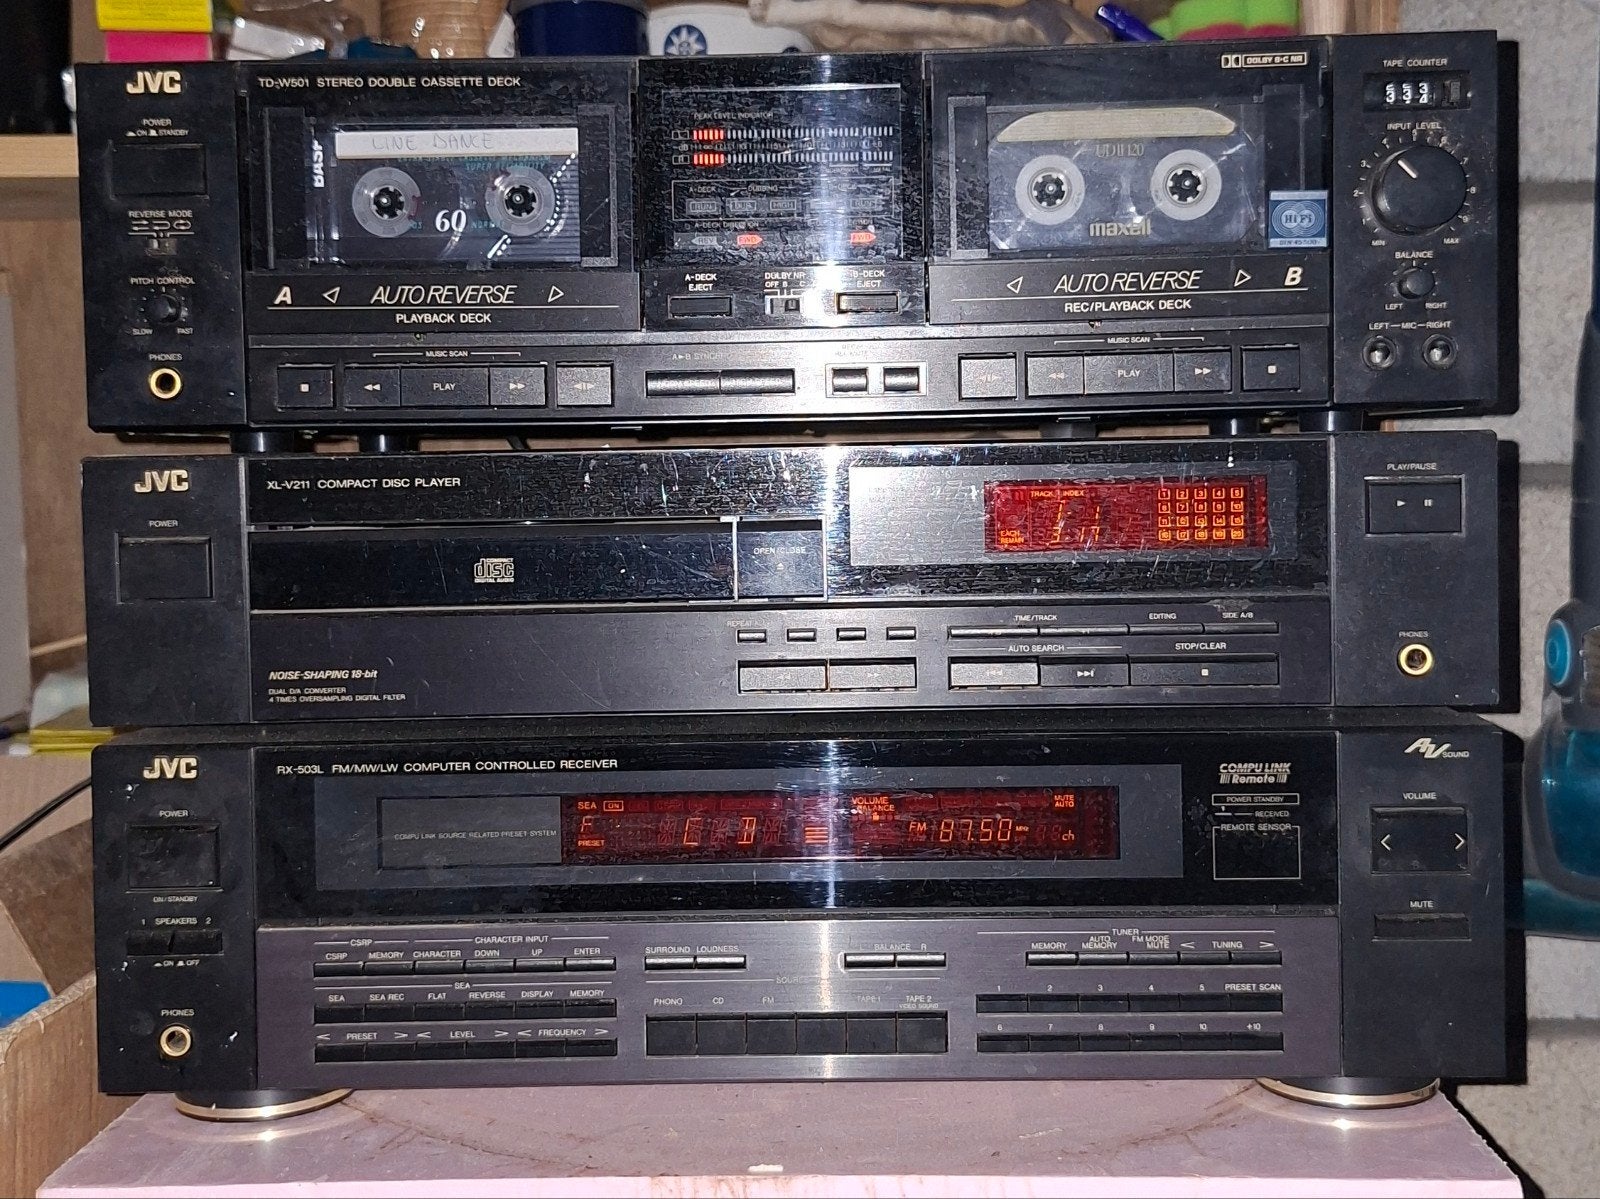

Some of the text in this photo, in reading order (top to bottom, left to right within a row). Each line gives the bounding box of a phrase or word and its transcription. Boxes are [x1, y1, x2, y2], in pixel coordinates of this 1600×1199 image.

[1407, 59, 1448, 67] COUNTER
[126, 70, 182, 94] JVC
[258, 76, 521, 88] TD-W501 STEREO DOUBLE CASSETTE DECK
[142, 118, 172, 126] POWER
[1387, 122, 1442, 130] INPUT LEVEL
[372, 133, 494, 151] LINE DANCE
[312, 139, 325, 188] BASF
[128, 210, 193, 218] REVERSE MODE
[435, 209, 467, 232] 60
[1089, 217, 1151, 237] maxell
[1371, 239, 1386, 247] MIN
[1395, 251, 1434, 259] BALANCE
[684, 273, 717, 281] A-DECK
[1284, 265, 1304, 286] B
[130, 277, 196, 285] PITCH CONTROL
[857, 280, 882, 288] EJECT
[1110, 270, 1203, 292] REVERSE
[688, 284, 714, 292] EJECT
[273, 286, 293, 305] A
[427, 285, 518, 304] REVERSE
[1064, 299, 1192, 313] REC/PLAYBACK DECK
[396, 313, 492, 324] PLAYBACK DECK
[1368, 322, 1390, 330] LEFT
[132, 328, 153, 336] SLOW
[177, 327, 193, 335] FAST
[149, 353, 182, 361] PHONES
[425, 350, 448, 358] MUSIC
[1117, 369, 1141, 378] PLAY
[433, 382, 456, 391] PLAY
[1387, 463, 1437, 471] PLAY/PAUSE
[134, 469, 189, 493] JVC
[267, 477, 461, 490] XL-V211 COMPACT DISC PLAYER
[149, 519, 178, 527] POWER
[1014, 614, 1058, 622] TIME/TRACK
[1222, 611, 1238, 619] SIDE
[1008, 645, 1030, 653] AUTO
[1175, 642, 1227, 650] STOP/CLEAR
[268, 671, 350, 681] NOISE-SHAPING
[304, 687, 347, 695] CONVERTER
[142, 756, 198, 779] JVC
[276, 759, 618, 775] RX-503L FM/MW/LW COMPUTER CONTROLLED RECEIVER
[1264, 762, 1292, 773] LINK
[1231, 774, 1276, 784] Remote
[1403, 792, 1437, 800] VOLUME
[577, 801, 598, 810] SEA
[159, 809, 189, 818] POWER
[1254, 810, 1290, 818] RECEIVED
[909, 821, 927, 833] FM
[1220, 822, 1292, 832] REMOTE SENSOR
[1409, 900, 1435, 909] MUTE
[155, 917, 198, 926] SPEAKERS
[1112, 928, 1139, 936] TUNER
[350, 938, 373, 947] CSRP
[474, 935, 549, 944] CHARACTER INPUT
[1089, 935, 1111, 943] AUTO
[1145, 935, 1170, 943] MODE
[1031, 942, 1067, 950] MEMORY
[1081, 941, 1117, 949] MEMORY
[1146, 941, 1170, 949] MUTE
[1212, 940, 1243, 949] TUNING
[413, 950, 462, 958] CHARACTER
[474, 949, 500, 957] DOWN
[531, 948, 543, 957] UP
[573, 947, 601, 955] ENTER
[645, 945, 740, 955] SURROUND LOUDNESS
[325, 952, 348, 961] CSRP
[368, 951, 404, 960] MEMORY
[163, 959, 174, 967] ON
[186, 959, 200, 967] OFF
[454, 981, 471, 990] SEA
[1224, 982, 1282, 991] PRESET SCAN
[328, 994, 345, 1002] SEA
[369, 993, 405, 1001] SEA REC
[427, 992, 447, 1000] FLAT
[468, 991, 506, 999] REVERSE
[520, 990, 554, 999] DISPLAY
[569, 989, 605, 998] MEMORY
[653, 997, 683, 1006] PHONO
[712, 996, 725, 1005] CD
[905, 995, 924, 1003] TAPE
[161, 1008, 195, 1017] PHONES
[1246, 1022, 1261, 1030] +10
[346, 1032, 378, 1040] PRESET
[449, 1030, 476, 1039] LEVEL
[537, 1028, 588, 1037] FREQUENCY
